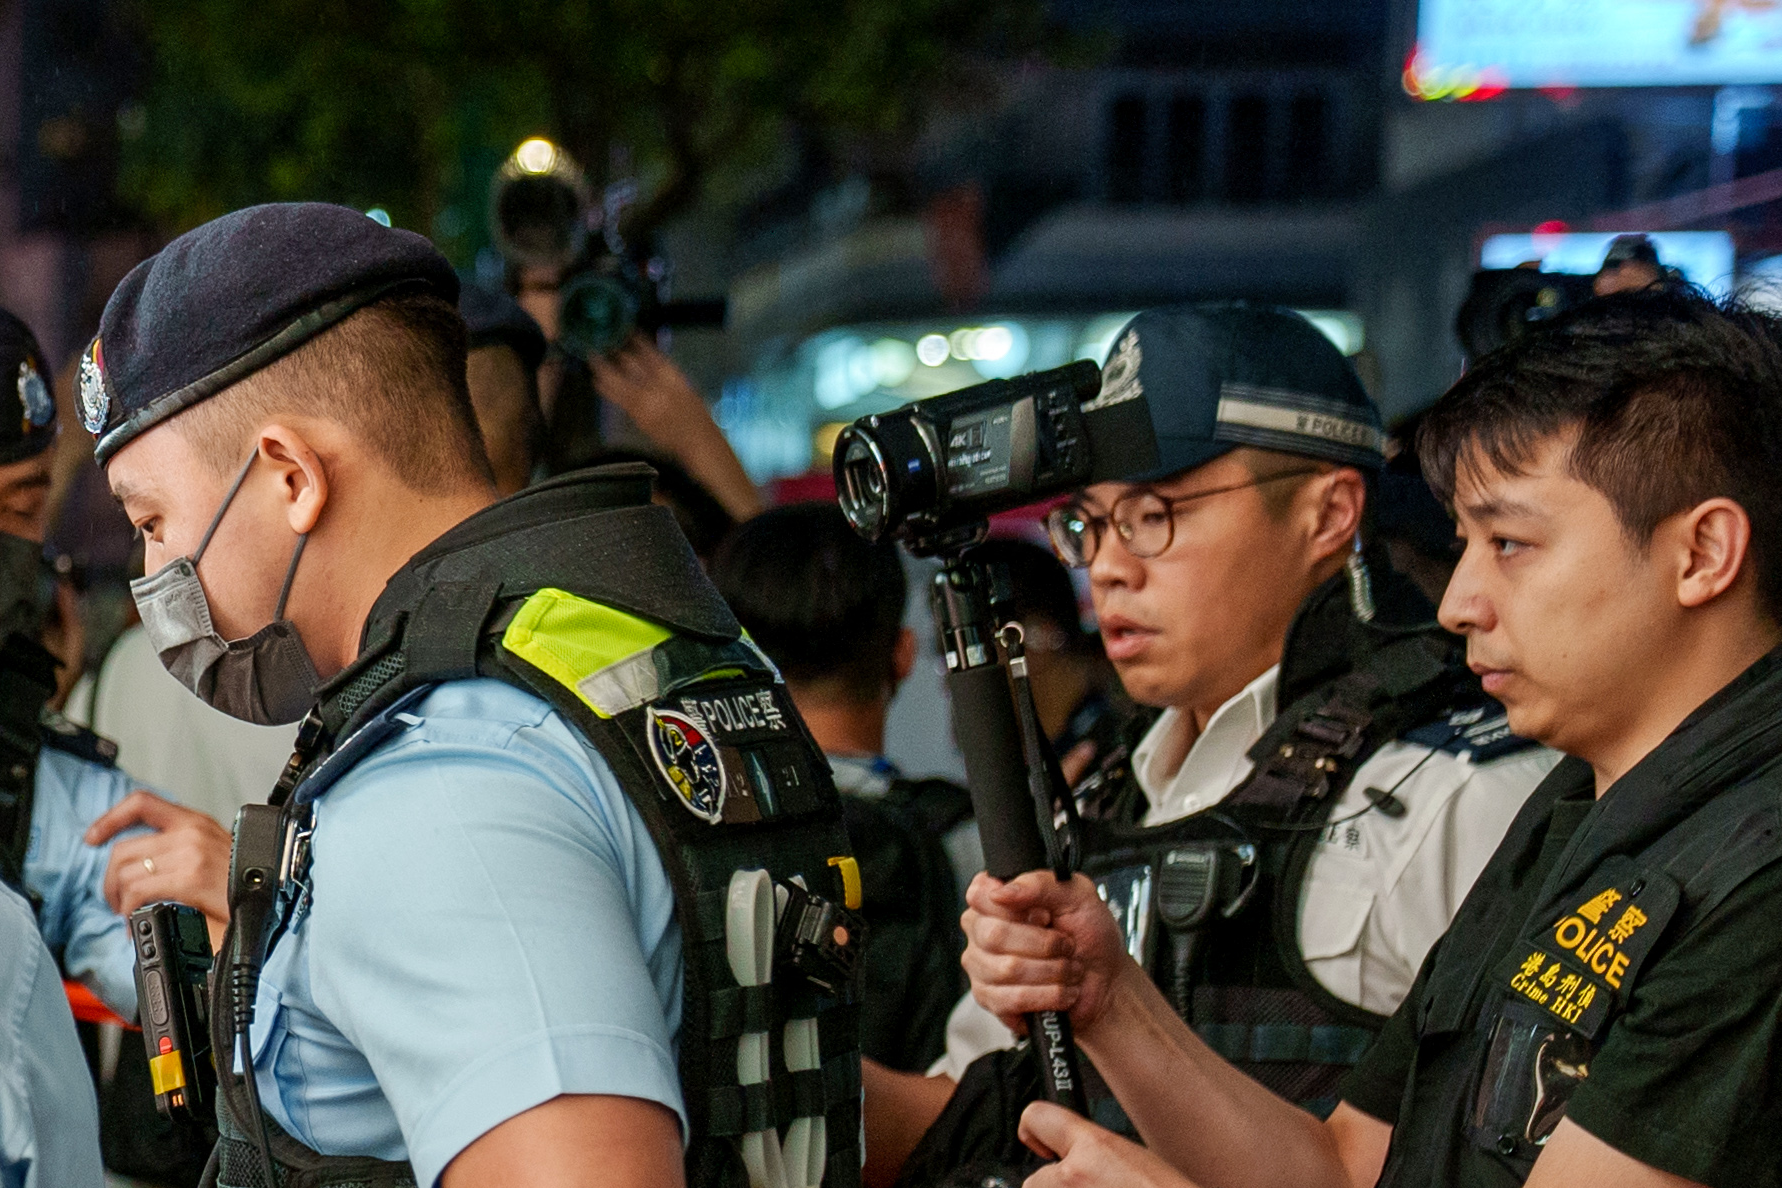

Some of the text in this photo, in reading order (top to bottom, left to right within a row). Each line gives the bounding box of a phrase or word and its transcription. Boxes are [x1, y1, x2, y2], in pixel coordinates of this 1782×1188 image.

[700, 694, 767, 733] POLICE
[1553, 915, 1632, 990] OLICE
[1510, 972, 1549, 1005] Crime
